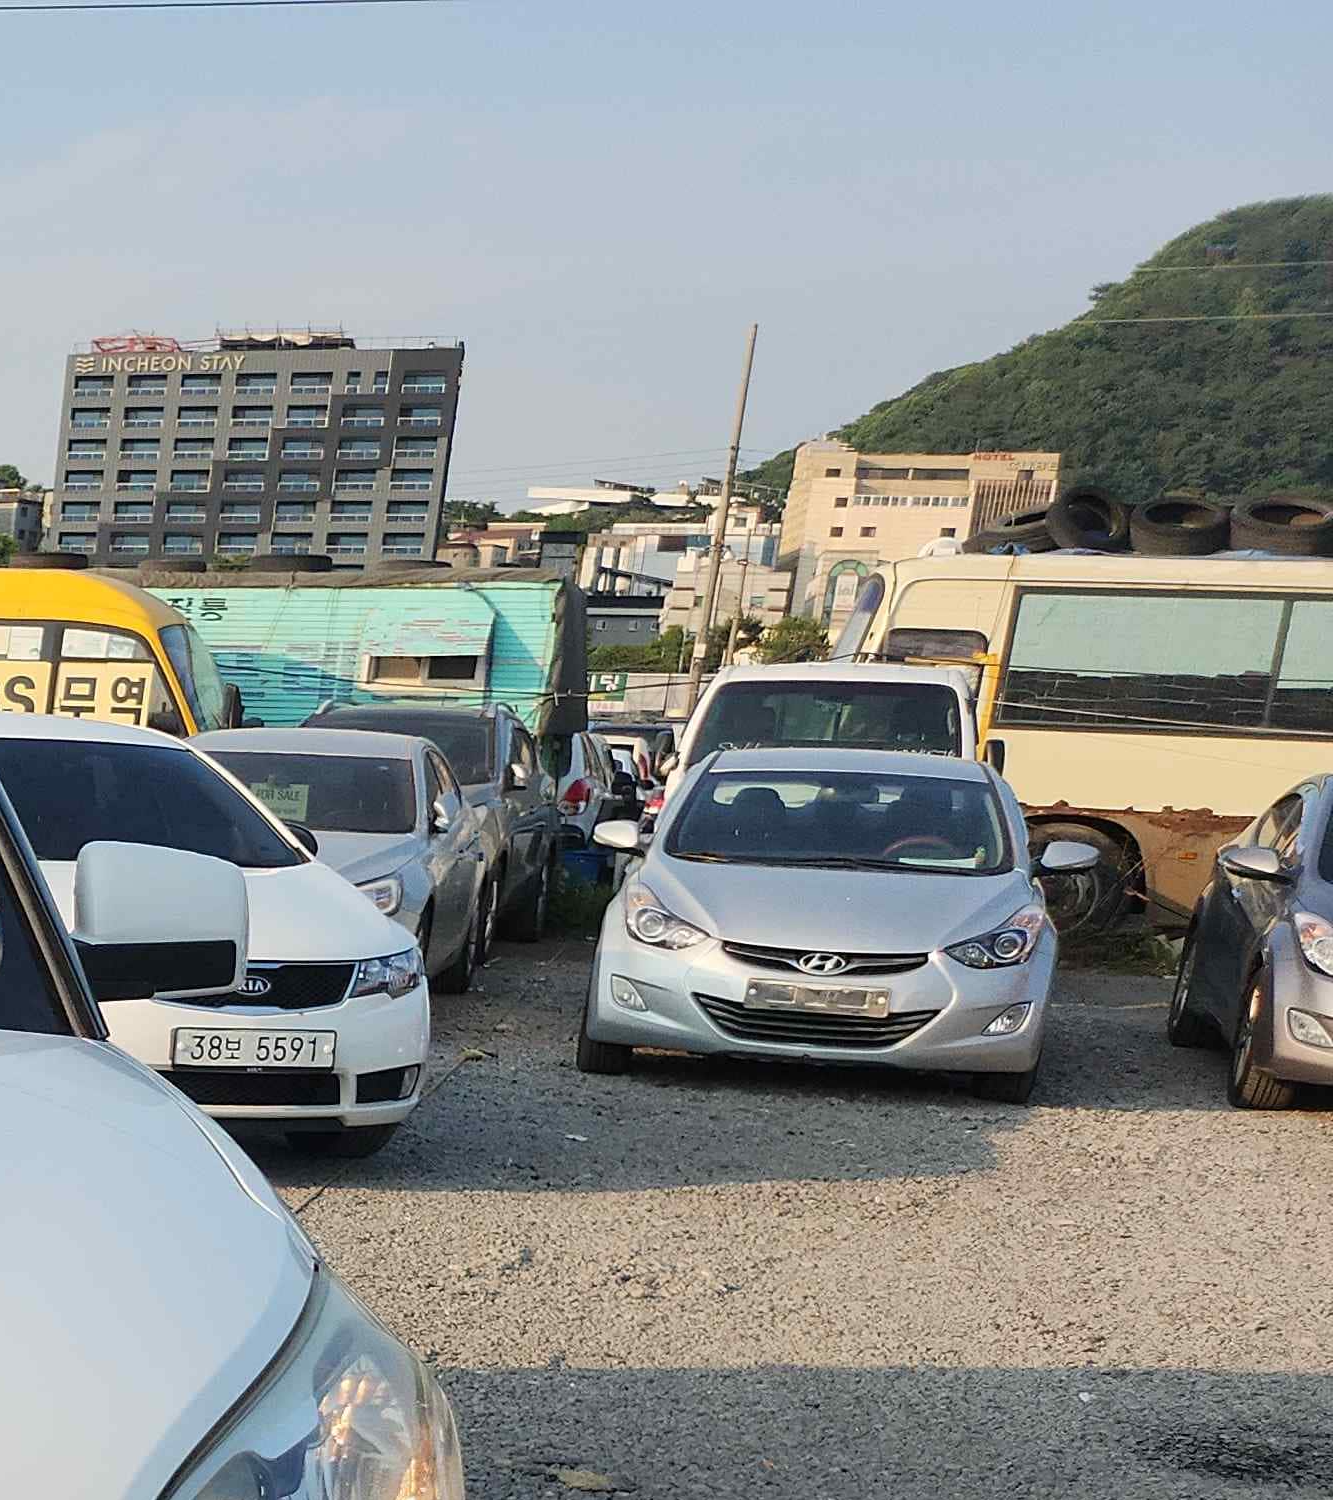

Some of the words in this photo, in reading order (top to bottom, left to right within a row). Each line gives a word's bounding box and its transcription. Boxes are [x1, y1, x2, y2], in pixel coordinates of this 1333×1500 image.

[101, 356, 192, 373] INCHEON
[200, 355, 246, 371] STAY
[974, 453, 1015, 461] HOTEL
[190, 1035, 242, 1060] 38보
[255, 1036, 317, 1062] 5591
